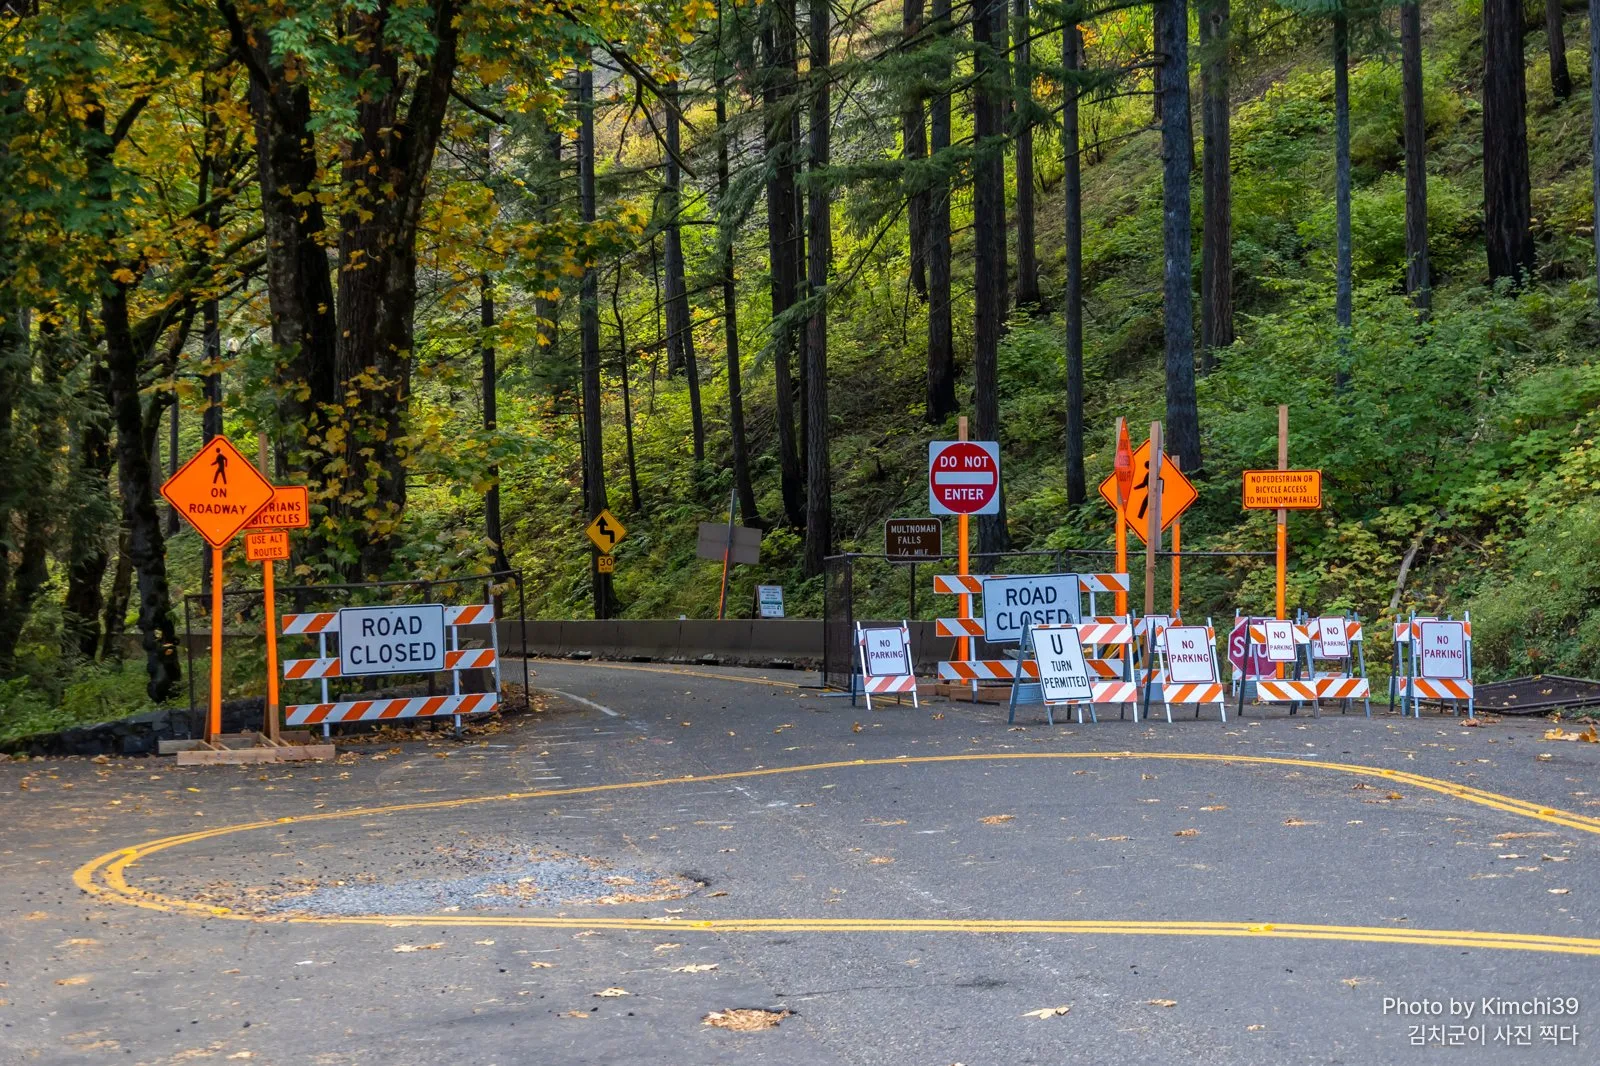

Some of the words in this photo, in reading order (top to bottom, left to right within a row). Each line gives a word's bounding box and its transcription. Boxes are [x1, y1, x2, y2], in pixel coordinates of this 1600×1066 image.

[940, 456, 957, 468] DO
[964, 456, 989, 468] NOT
[1251, 475, 1261, 483] NO
[1263, 475, 1302, 483] PEDESTRIAN
[1303, 474, 1313, 482] OR
[211, 488, 227, 498] ON
[944, 488, 984, 500] ENTER
[1283, 485, 1307, 493] ACCESS
[1247, 496, 1255, 504] TO
[1256, 496, 1297, 504] MULTNOMAH
[1299, 495, 1318, 503] FALLS
[189, 503, 247, 515] ROADWAY
[891, 524, 936, 534] MULTNOMAH
[251, 534, 266, 545] USE
[269, 534, 283, 544] ALT
[897, 536, 922, 545] FALLS
[253, 547, 283, 558] ROUTES
[600, 557, 613, 566] 30
[1005, 586, 1057, 607] ROAD
[996, 609, 1069, 631] CLOSED
[362, 616, 423, 637] ROAD
[1326, 626, 1339, 635] NO
[1273, 631, 1286, 639] NO
[1436, 635, 1449, 645] NO
[879, 639, 891, 648] NO
[1050, 634, 1063, 655] U
[1181, 640, 1194, 650] NO
[350, 642, 436, 665] CLOSED
[870, 650, 904, 659] PARKING
[1171, 653, 1209, 663] PARKING
[1424, 649, 1462, 659] PARKING
[1051, 660, 1073, 672] TURN
[1044, 675, 1087, 689] PERMITTED
